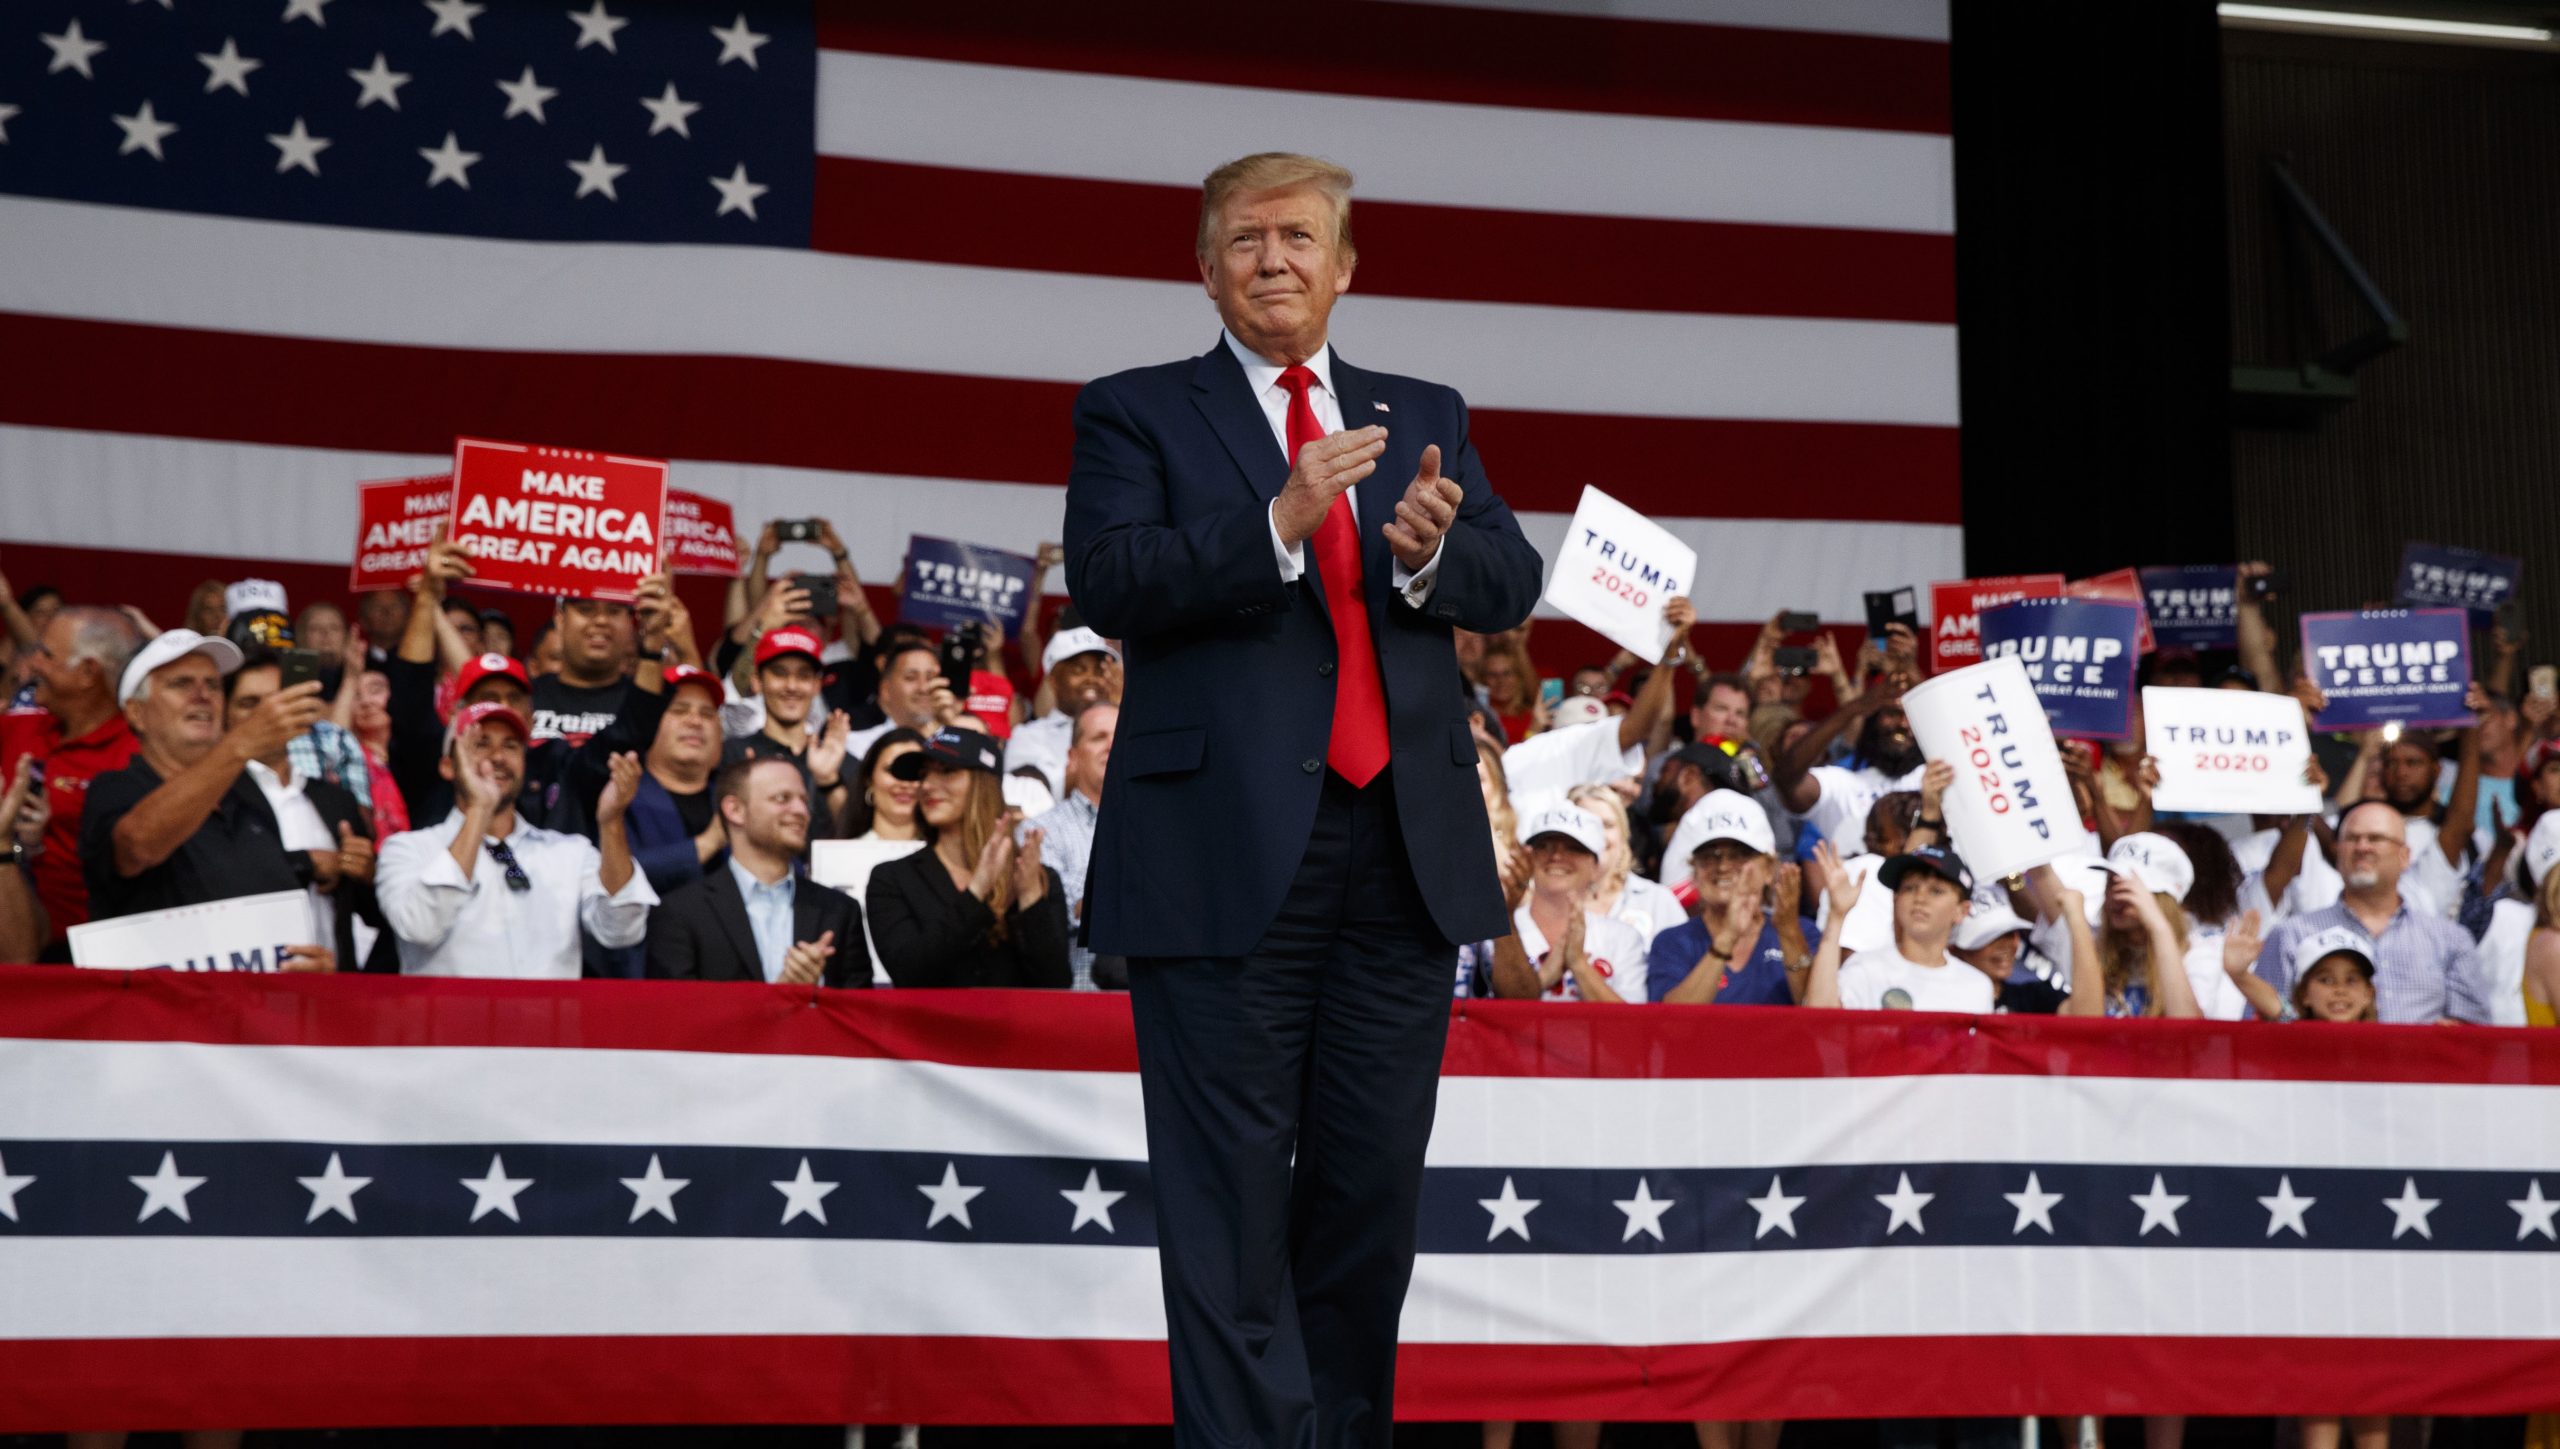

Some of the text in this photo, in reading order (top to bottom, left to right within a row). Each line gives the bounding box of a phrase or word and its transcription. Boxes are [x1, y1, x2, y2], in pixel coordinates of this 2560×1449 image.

[521, 468, 606, 501] MAKE
[404, 490, 451, 516] MAK
[666, 500, 701, 517] AKE
[460, 493, 654, 546] AMERICA
[664, 515, 734, 546] ERICA
[458, 533, 558, 566] GREAT
[559, 545, 653, 576] AGAIN
[1584, 527, 1679, 593] TRUMP
[915, 559, 1025, 594] TRUMP
[1591, 566, 1649, 609] 2020
[2410, 561, 2509, 592] TRUMP
[922, 578, 1014, 607] PENCE
[2150, 587, 2237, 608] TRUM
[1938, 639, 1982, 657] GRE
[2317, 640, 2460, 671] TRUMP
[2022, 663, 2105, 685] NCE
[2332, 664, 2450, 687] PENCE
[2034, 682, 2075, 697] GREAT
[2164, 725, 2293, 747] TRUMP
[1959, 725, 2011, 815] 2020
[1976, 683, 2051, 840] TRUMP
[2195, 752, 2270, 773] 2020
[1542, 809, 1584, 829] USA
[1707, 812, 1749, 831] USA
[150, 944, 294, 973] UMP
